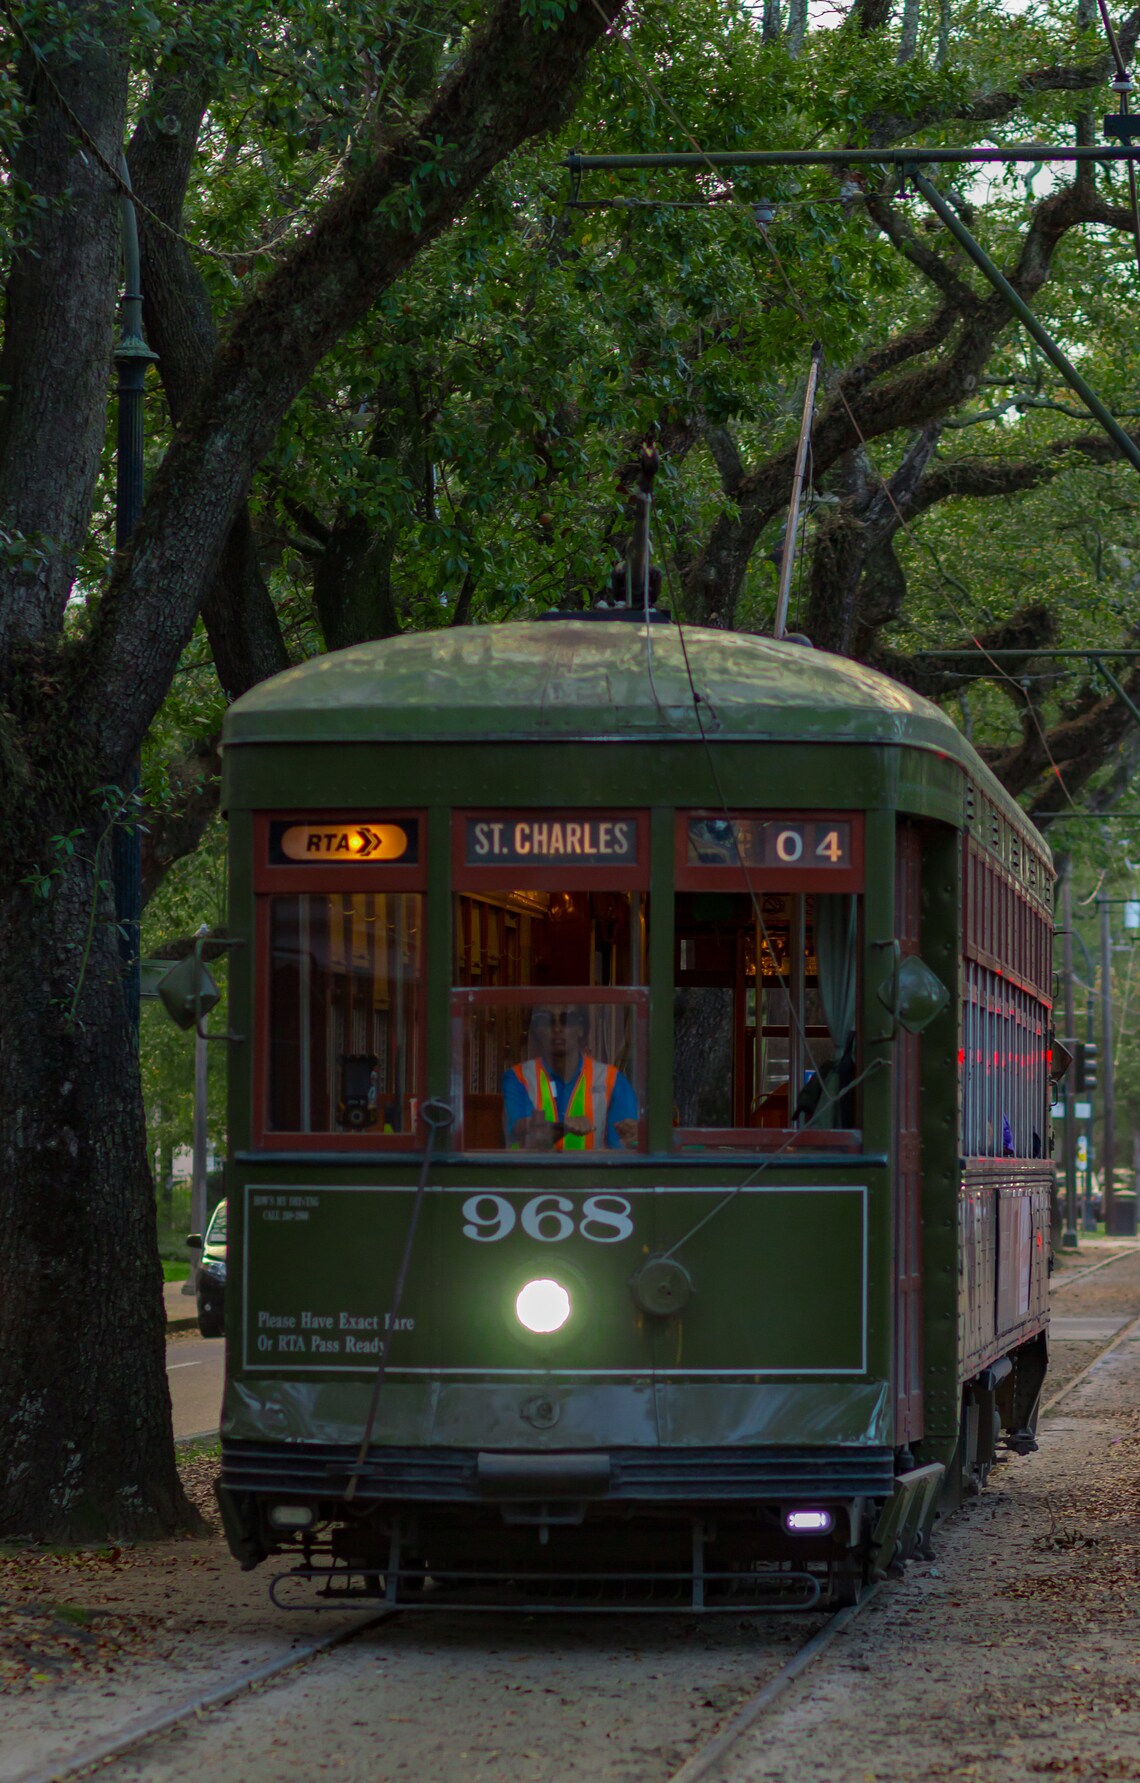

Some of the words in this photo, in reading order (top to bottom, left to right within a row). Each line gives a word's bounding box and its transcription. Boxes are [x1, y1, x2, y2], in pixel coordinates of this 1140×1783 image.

[306, 829, 350, 853] RTA
[475, 822, 508, 855] ST.
[514, 822, 629, 855] CHARLES
[461, 1193, 634, 1243] 968
[258, 1311, 296, 1329] Please
[301, 1311, 334, 1329] Have
[339, 1312, 379, 1330] Exact
[257, 1334, 273, 1352] Or
[278, 1334, 306, 1352] RTA
[311, 1335, 340, 1353] Pass
[345, 1336, 385, 1356] Ready
